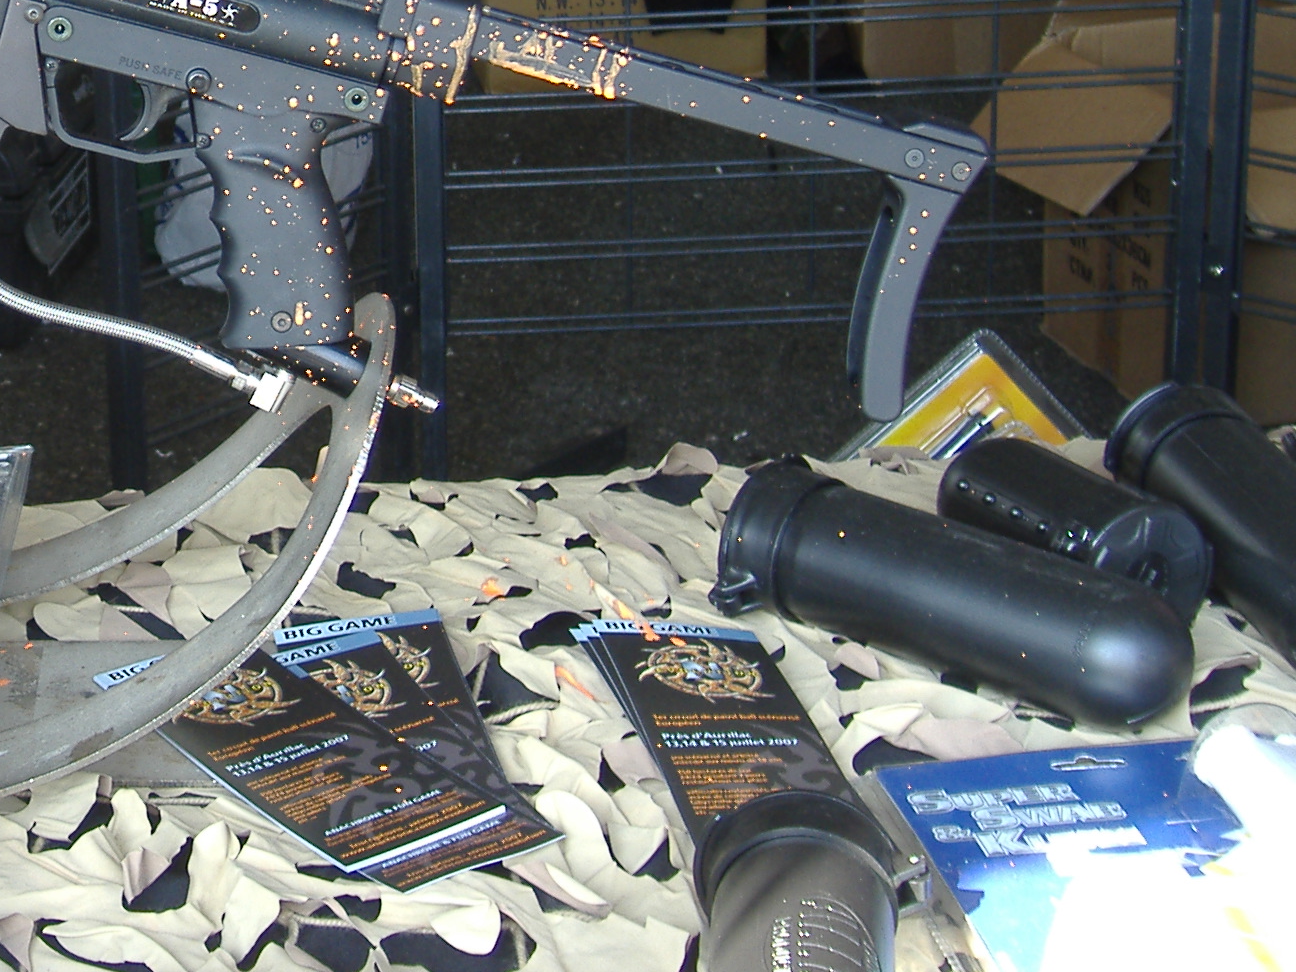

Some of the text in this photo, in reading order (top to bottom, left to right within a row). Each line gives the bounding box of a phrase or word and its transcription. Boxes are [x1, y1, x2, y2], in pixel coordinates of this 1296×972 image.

[153, 62, 182, 79] SAFE
[283, 614, 396, 641] BIG GAME
[322, 734, 349, 749] 2007
[729, 738, 766, 748] juillet
[768, 738, 799, 747] 2007
